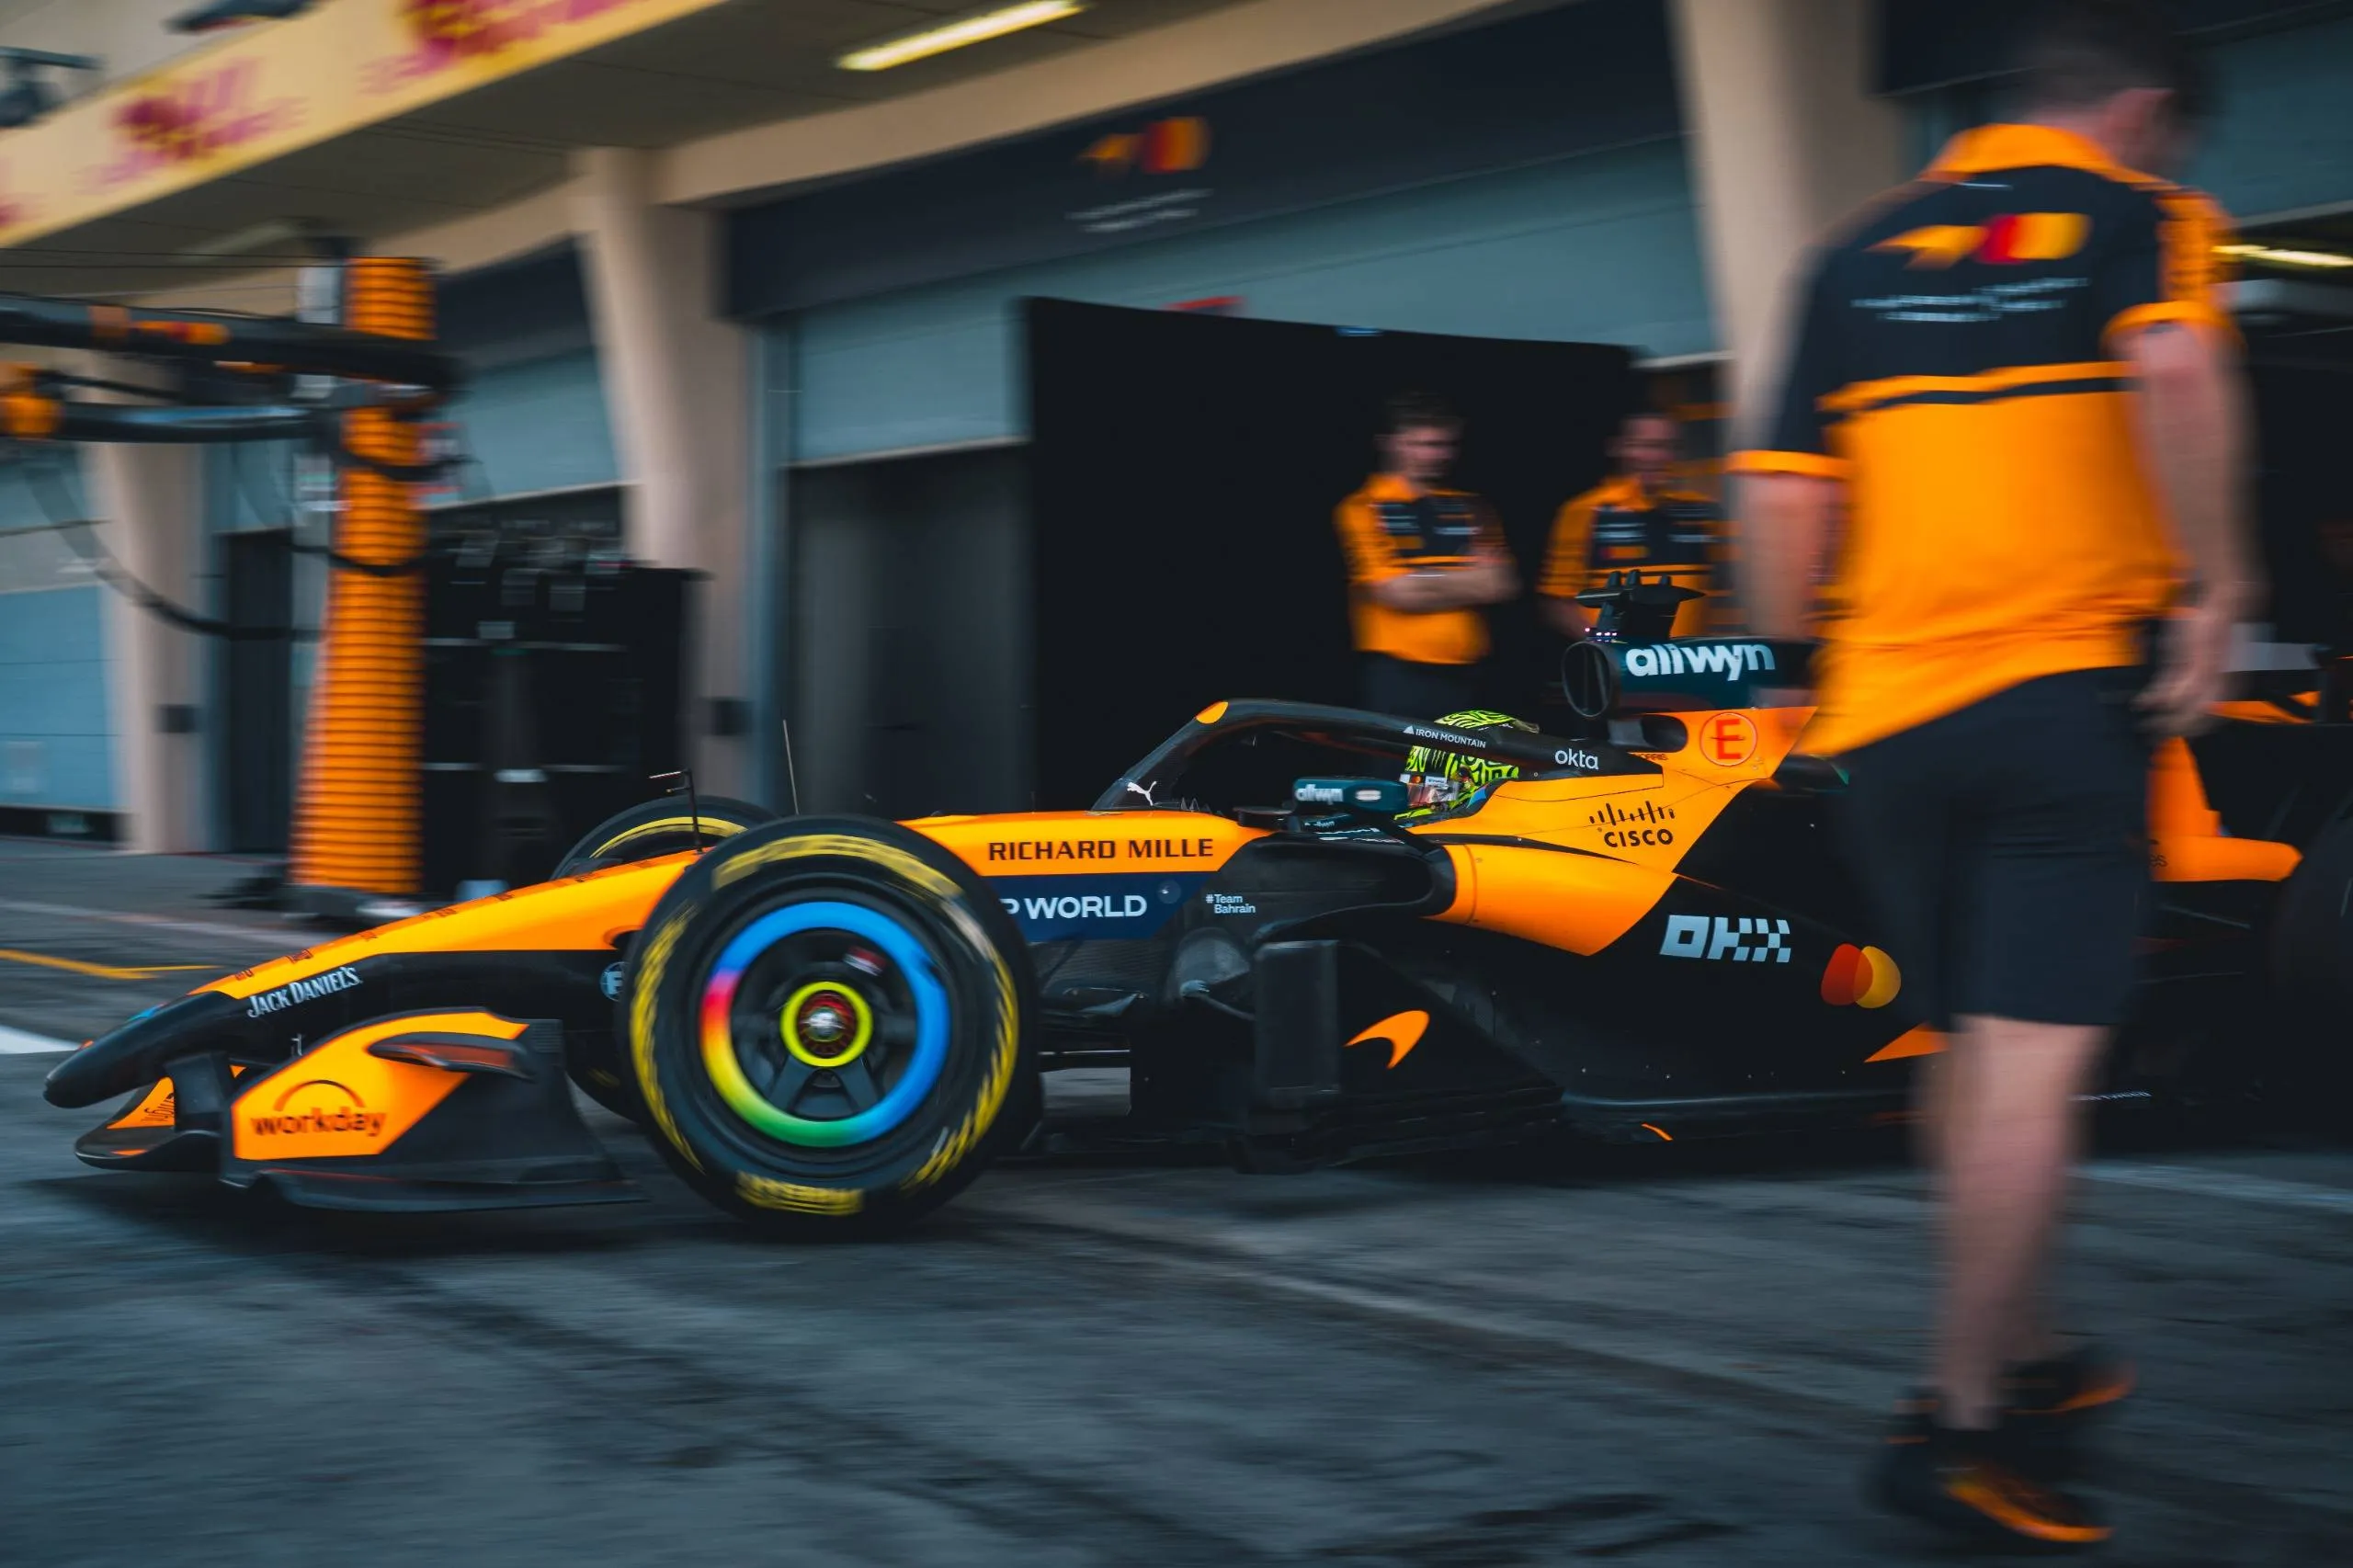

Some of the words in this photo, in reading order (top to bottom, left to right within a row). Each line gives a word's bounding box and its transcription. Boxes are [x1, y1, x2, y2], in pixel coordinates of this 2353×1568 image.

[1625, 643, 1775, 681] allwyn
[1415, 729, 1439, 740] IRON
[1439, 733, 1486, 748] MOUNTAIN
[1716, 719, 1741, 759] E
[1554, 748, 1599, 770] okta
[988, 839, 1117, 861] RICHARD
[1128, 838, 1213, 858] MILLE
[1604, 828, 1674, 847] CISCO
[998, 898, 1020, 915] P
[1023, 895, 1148, 920] WORLD
[1206, 893, 1244, 903] #Team
[1214, 903, 1256, 914] Bahrain
[1659, 915, 1791, 962] OKX
[246, 989, 292, 1017] JACK
[251, 1106, 387, 1137] workday
